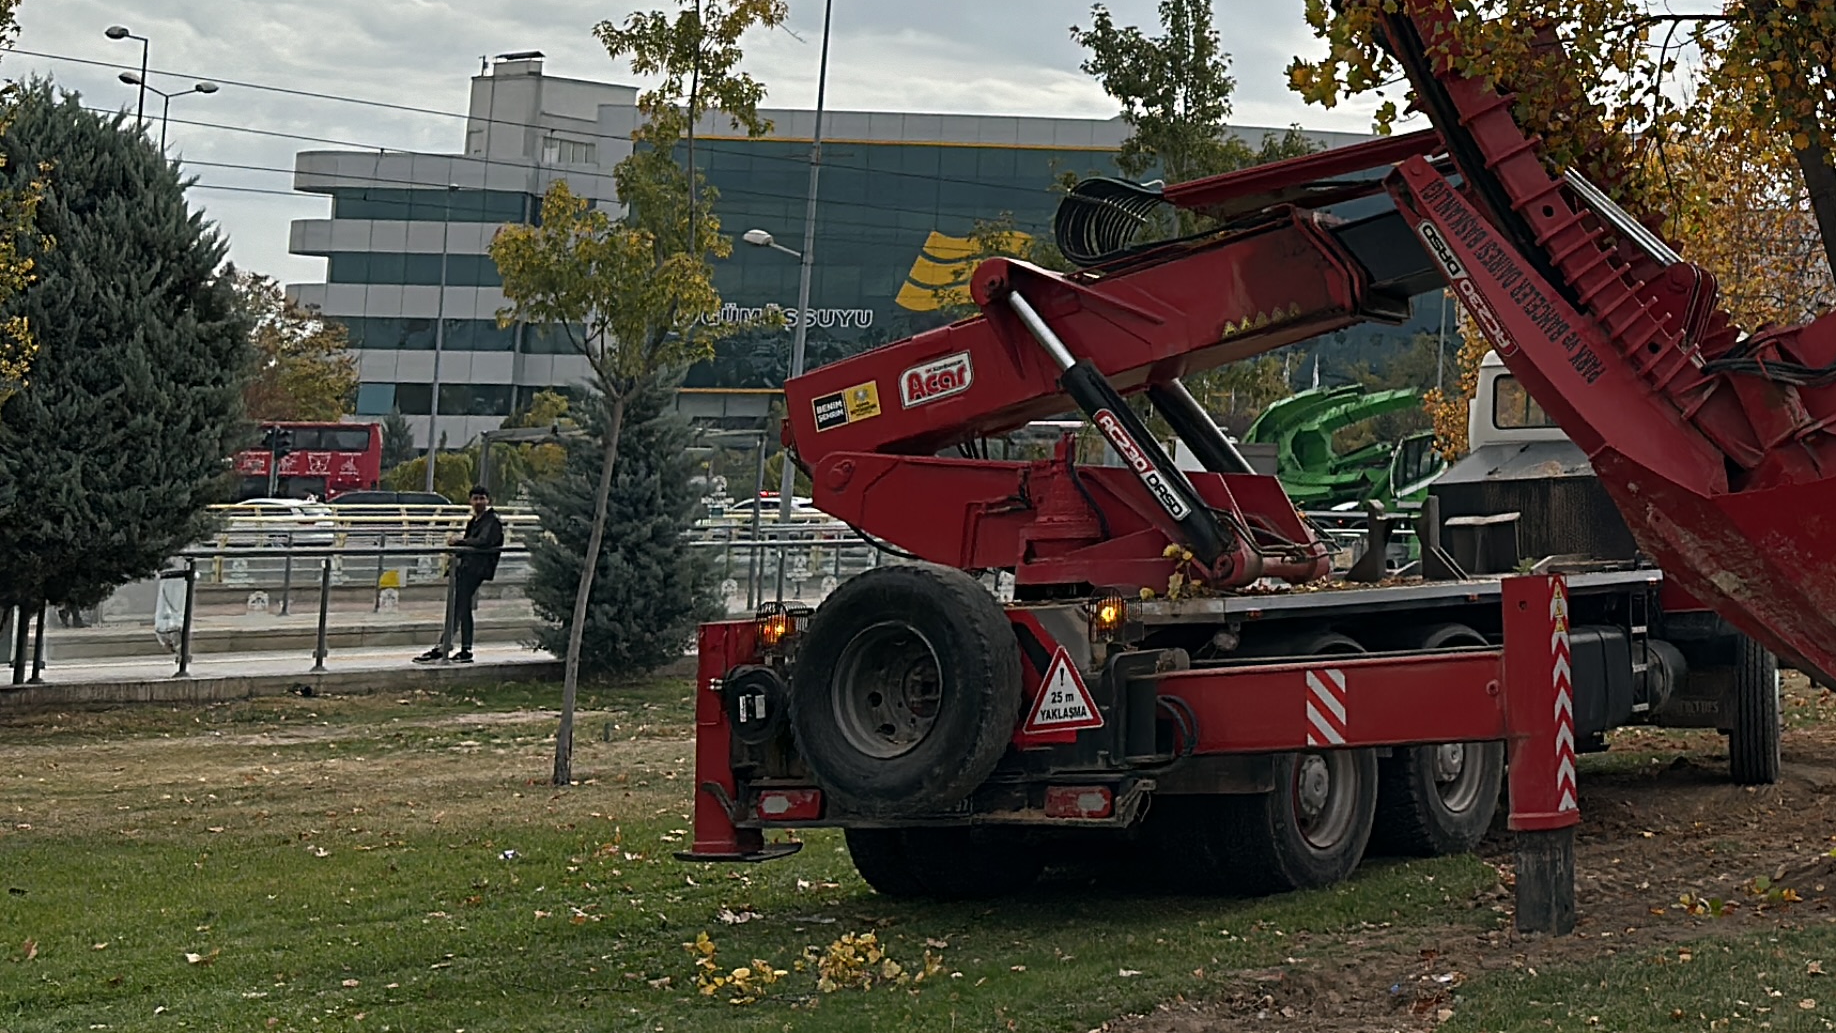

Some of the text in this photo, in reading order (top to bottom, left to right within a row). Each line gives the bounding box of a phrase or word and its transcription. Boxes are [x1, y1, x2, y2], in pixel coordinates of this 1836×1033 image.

[700, 303, 873, 332] GÜMŞSUYU
[1561, 331, 1581, 352] ve
[1569, 342, 1607, 385] PARK
[907, 363, 967, 402] Acar
[1051, 691, 1074, 704] 25 m
[1040, 705, 1087, 722] YAKLAŞMA
